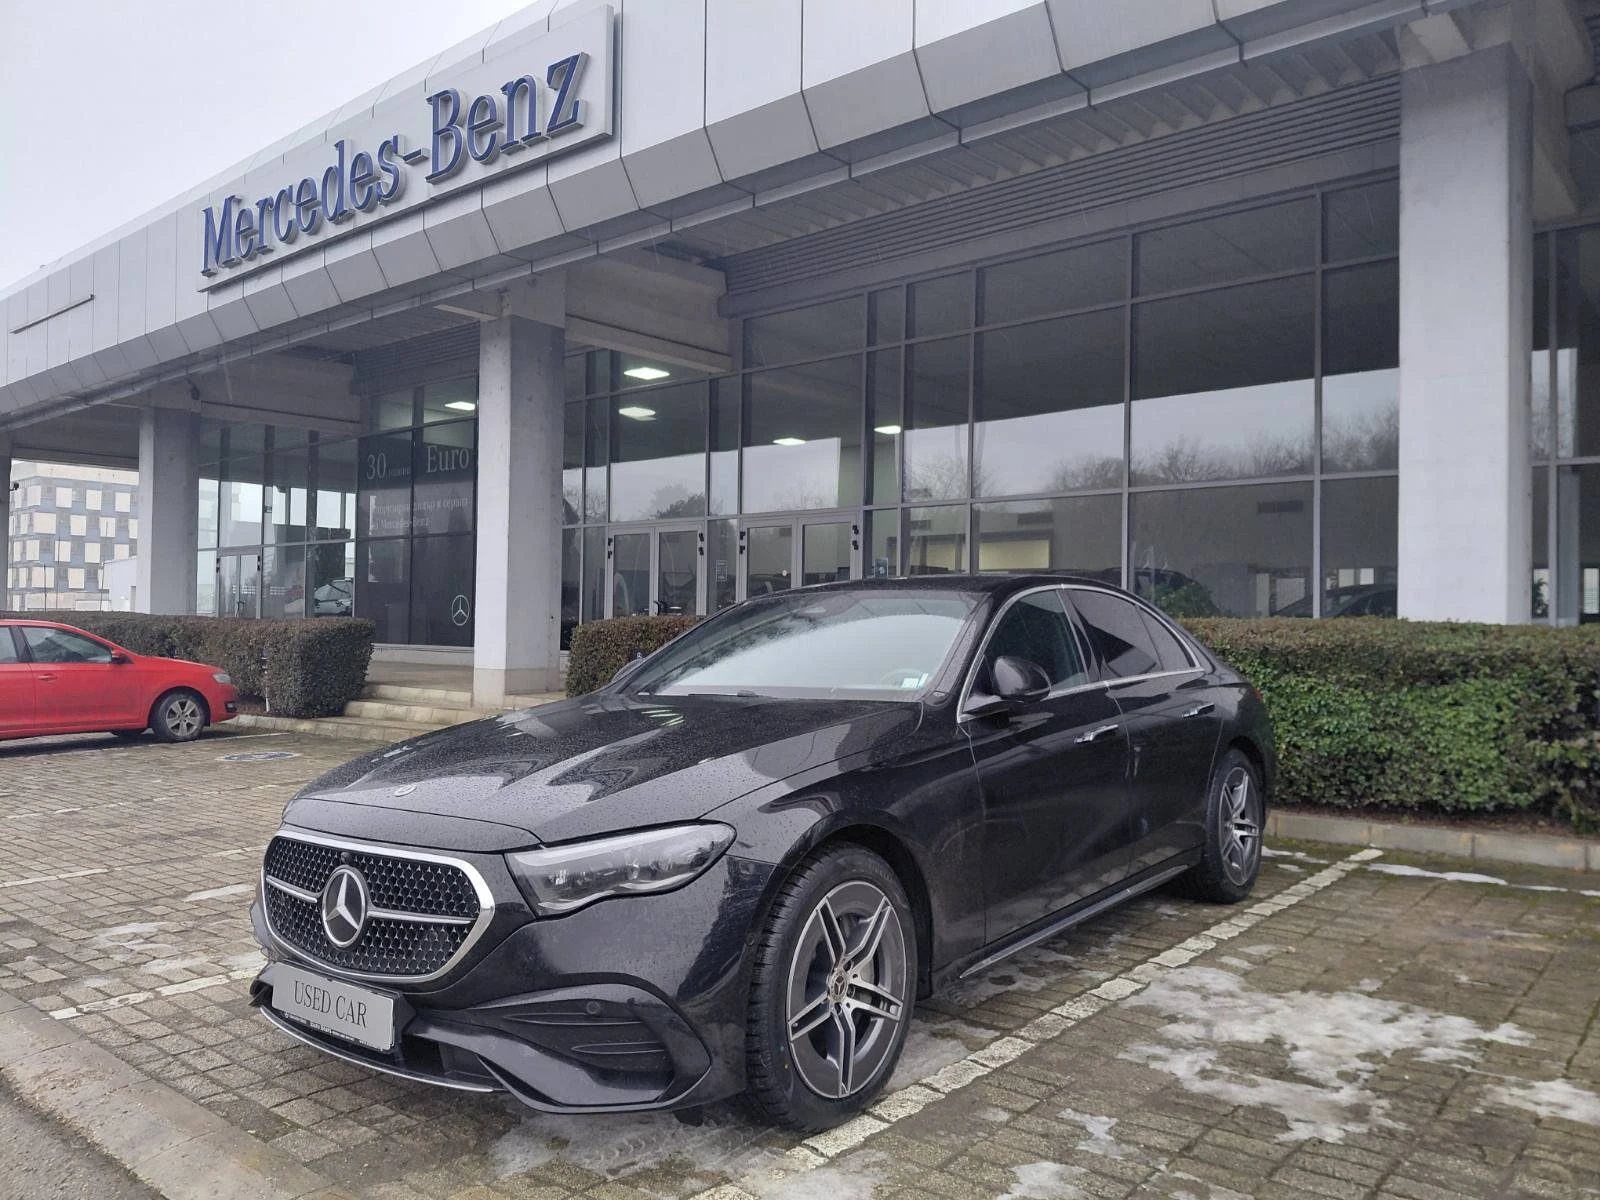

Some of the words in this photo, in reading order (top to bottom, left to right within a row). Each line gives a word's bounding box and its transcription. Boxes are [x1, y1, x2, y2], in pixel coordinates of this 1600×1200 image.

[201, 51, 590, 277] Mercedes-Benz
[366, 452, 386, 480] 30
[426, 446, 469, 473] Euro
[294, 980, 331, 1013] USED
[336, 995, 367, 1028] CAR
